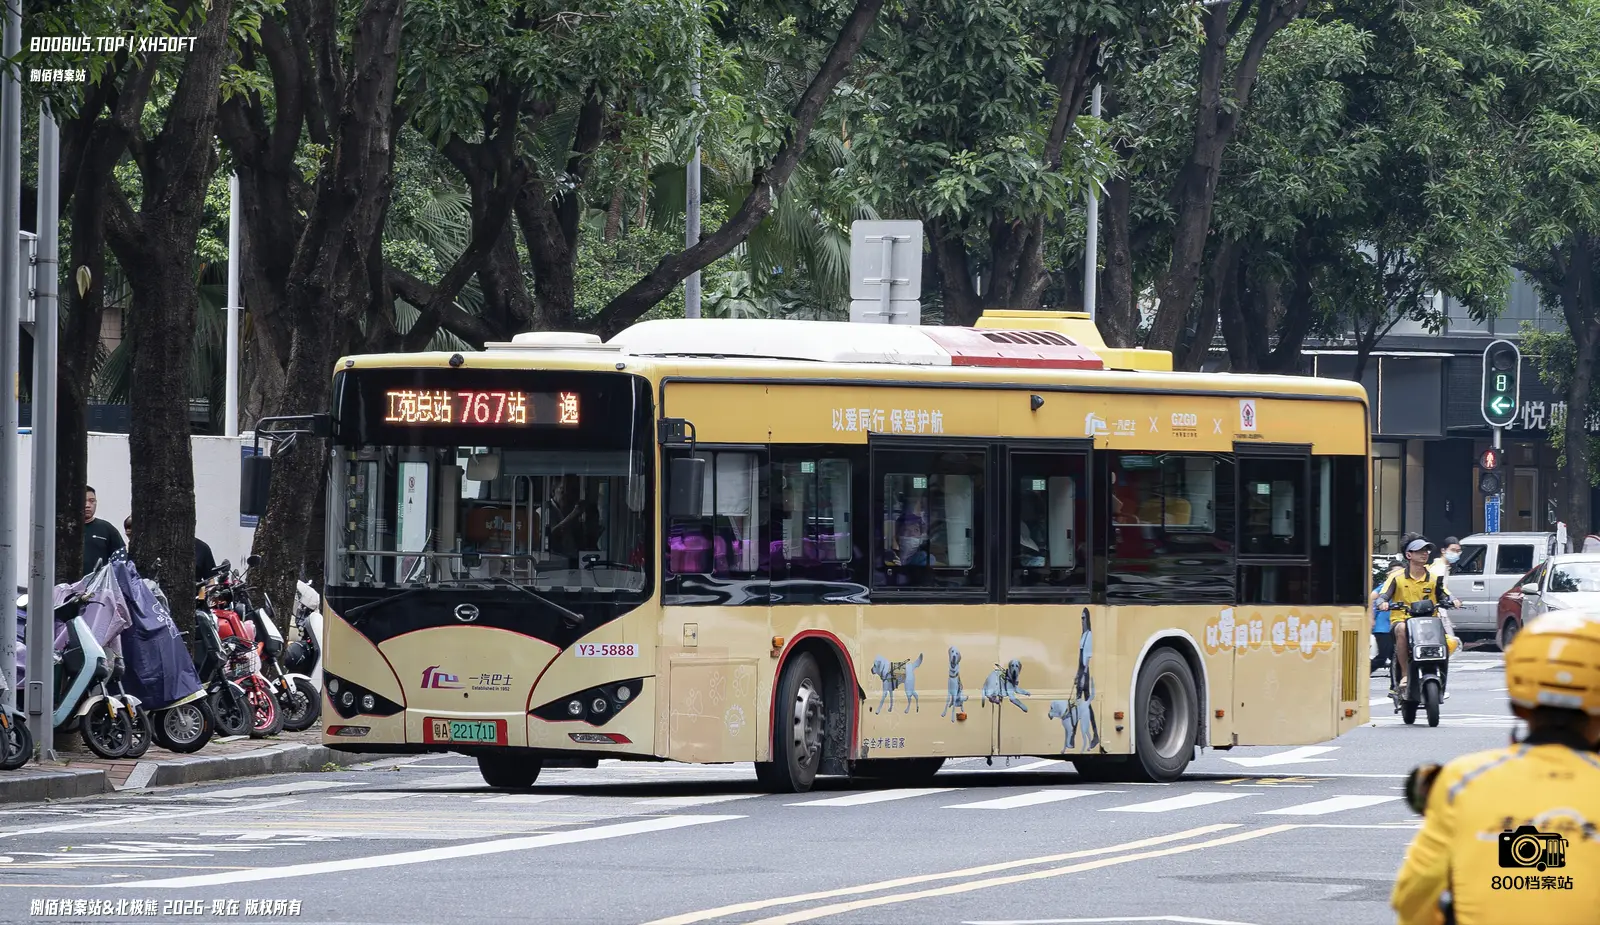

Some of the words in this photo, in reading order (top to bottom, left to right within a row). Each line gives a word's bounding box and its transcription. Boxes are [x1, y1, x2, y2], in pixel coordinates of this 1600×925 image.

[1496, 374, 1507, 392] 8
[457, 392, 506, 423] 767
[559, 391, 579, 424] 逸
[831, 408, 885, 433] 以爱同行
[890, 408, 944, 433] 保驾护航
[1171, 412, 1197, 427] GZGD
[579, 644, 634, 656] Y3-5888
[468, 673, 513, 686] 一汽巴士
[862, 737, 906, 749] 安全才能回家
